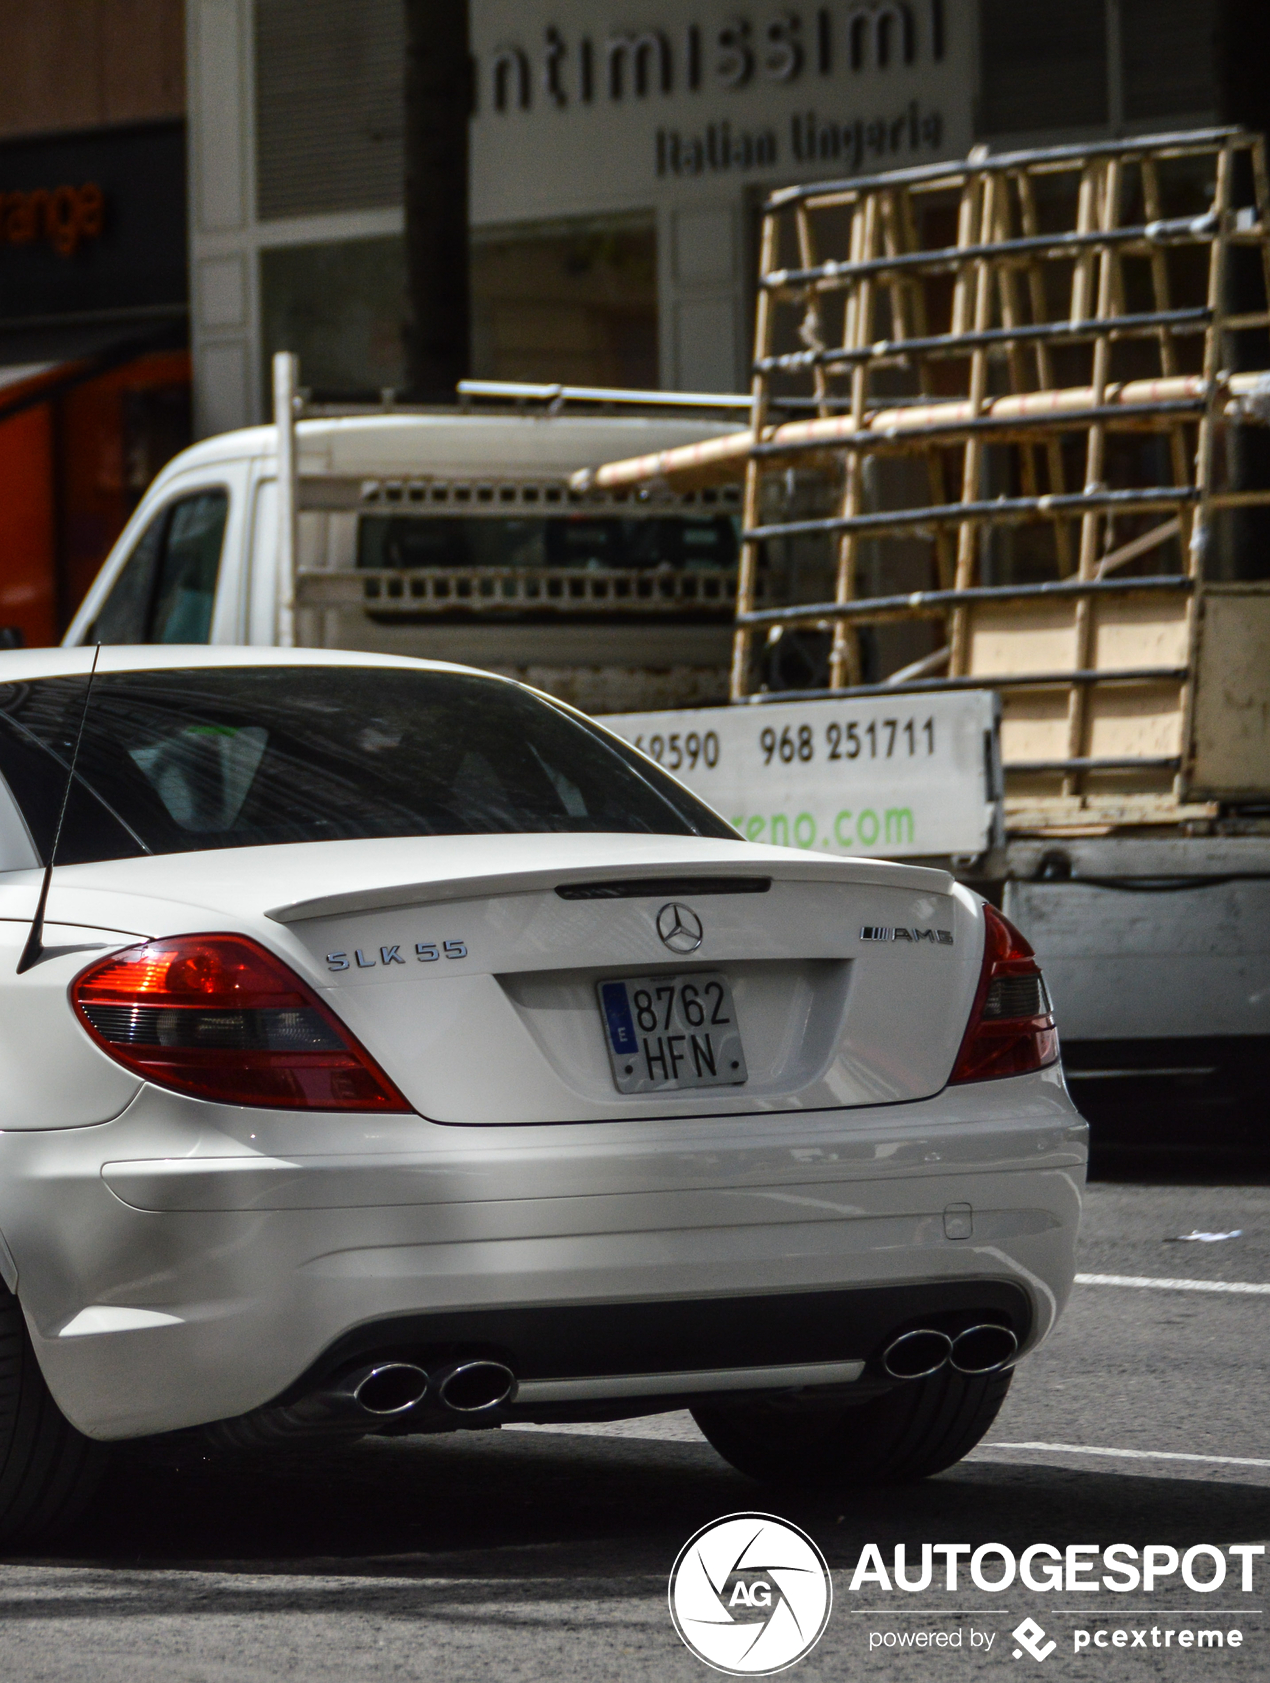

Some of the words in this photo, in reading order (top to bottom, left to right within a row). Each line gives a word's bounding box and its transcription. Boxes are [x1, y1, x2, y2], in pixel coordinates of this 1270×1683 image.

[656, 119, 777, 178] Italian
[760, 724, 814, 766] 968
[826, 715, 936, 761] 251711
[326, 945, 406, 972] SLK
[415, 938, 468, 963] 55
[891, 927, 954, 946] AMG
[633, 981, 730, 1032] 8762
[617, 1026, 629, 1043] E
[643, 1033, 717, 1081] HFN
